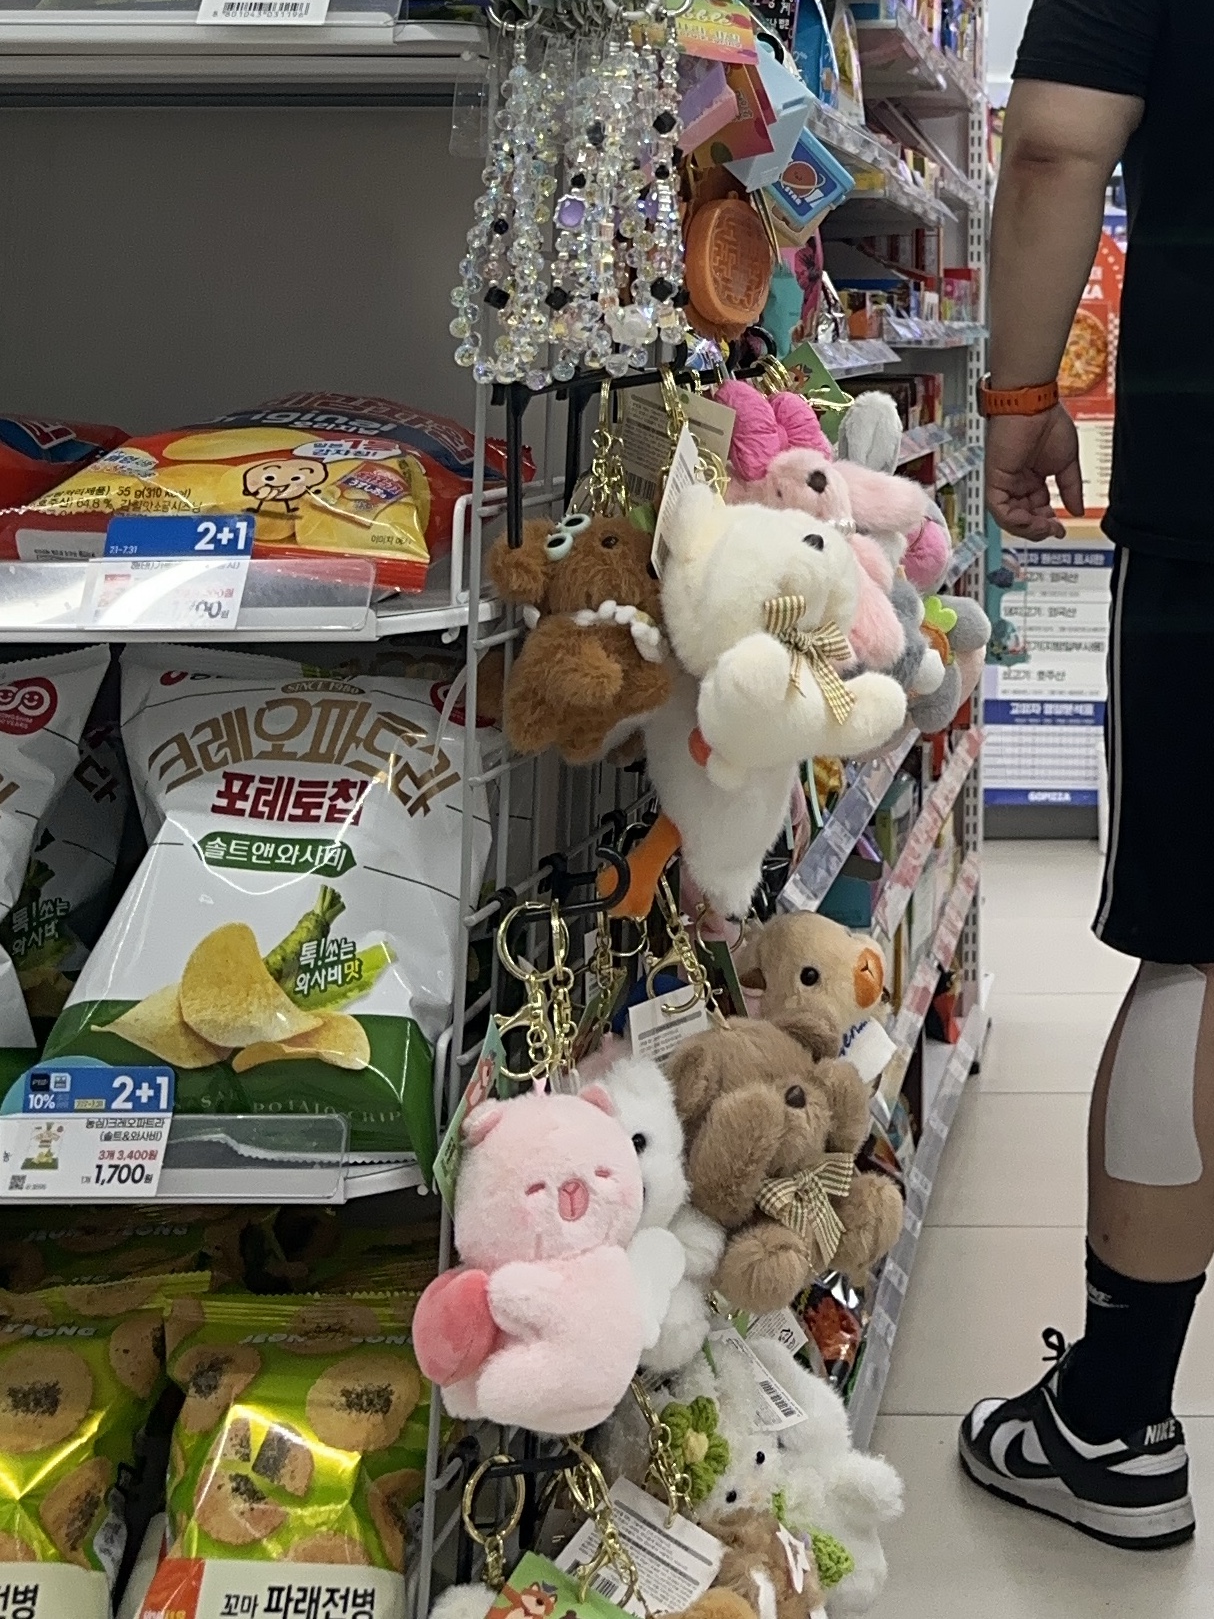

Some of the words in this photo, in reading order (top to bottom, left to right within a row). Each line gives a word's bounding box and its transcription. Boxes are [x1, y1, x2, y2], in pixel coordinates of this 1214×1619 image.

[116, 485, 131, 497] 55
[194, 521, 249, 551] 2+1
[287, 682, 325, 693] SINCE
[148, 698, 461, 818] 크레오파트라
[211, 770, 371, 827] 포테토칩
[204, 836, 348, 872] 솔트앤와사비
[294, 958, 363, 996] 와사비맛
[28, 1093, 56, 1110] 10%
[111, 1075, 170, 1110] 2+1
[86, 1118, 165, 1129] 농심)크레오파트라
[99, 1131, 163, 1142] (솔트&와사비)
[98, 1150, 116, 1161] 3개
[117, 1150, 158, 1161] 3,400원
[1144, 1416, 1177, 1446] NIKE
[220, 1594, 260, 1618] 꼬마
[264, 1584, 376, 1619] 파래전병
